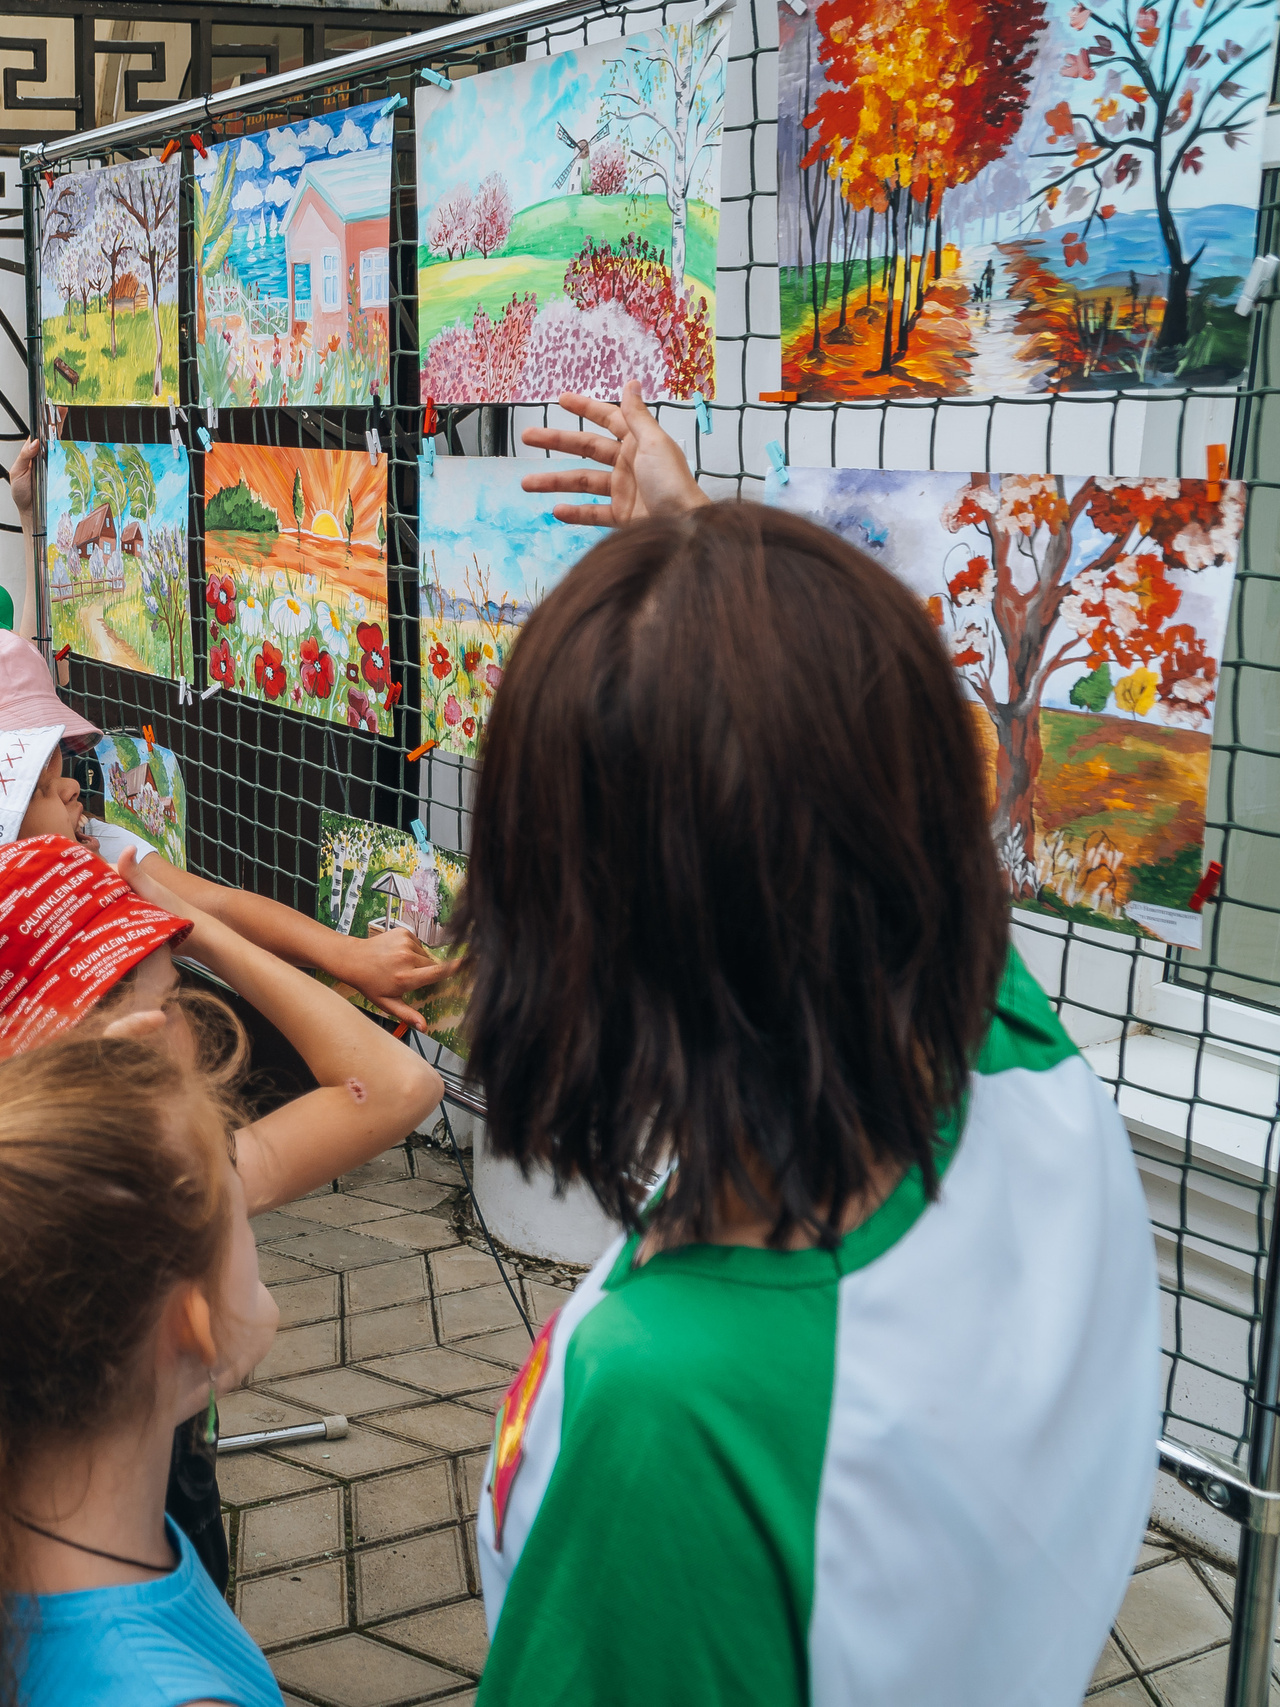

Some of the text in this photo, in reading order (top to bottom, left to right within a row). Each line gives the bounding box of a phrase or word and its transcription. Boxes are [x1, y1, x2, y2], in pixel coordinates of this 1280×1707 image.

[24, 862, 65, 898] CALVIN KLEIN JEANS
[19, 902, 51, 934] CALVIN
[46, 883, 73, 907] KLEIN
[68, 869, 93, 888] JEANS
[33, 918, 52, 938] CALVIN
[49, 906, 64, 922] KLEIN
[62, 894, 78, 910] JEANS
[49, 893, 93, 934] CALVIN KLEIN JEANS
[29, 947, 47, 966] CALVIN
[44, 934, 59, 950] KLEIN
[57, 920, 73, 937] JEANS
[81, 929, 100, 942] CALVIN
[97, 923, 114, 933] KLEIN
[112, 917, 129, 926] JEANS
[70, 950, 101, 977] CALVIN
[98, 936, 127, 954] KLEIN
[126, 926, 156, 942] JEANS
[81, 945, 129, 981] CALVIN KLEIN JEANS
[95, 946, 145, 977] CALVIN KLEIN JEANS
[3, 989, 17, 1003] KLEIN
[14, 977, 28, 993] JEANS
[45, 974, 60, 989] JEANS
[73, 967, 117, 1008] CALVIN KLEIN JEANS
[36, 1007, 58, 1032] JEANS
